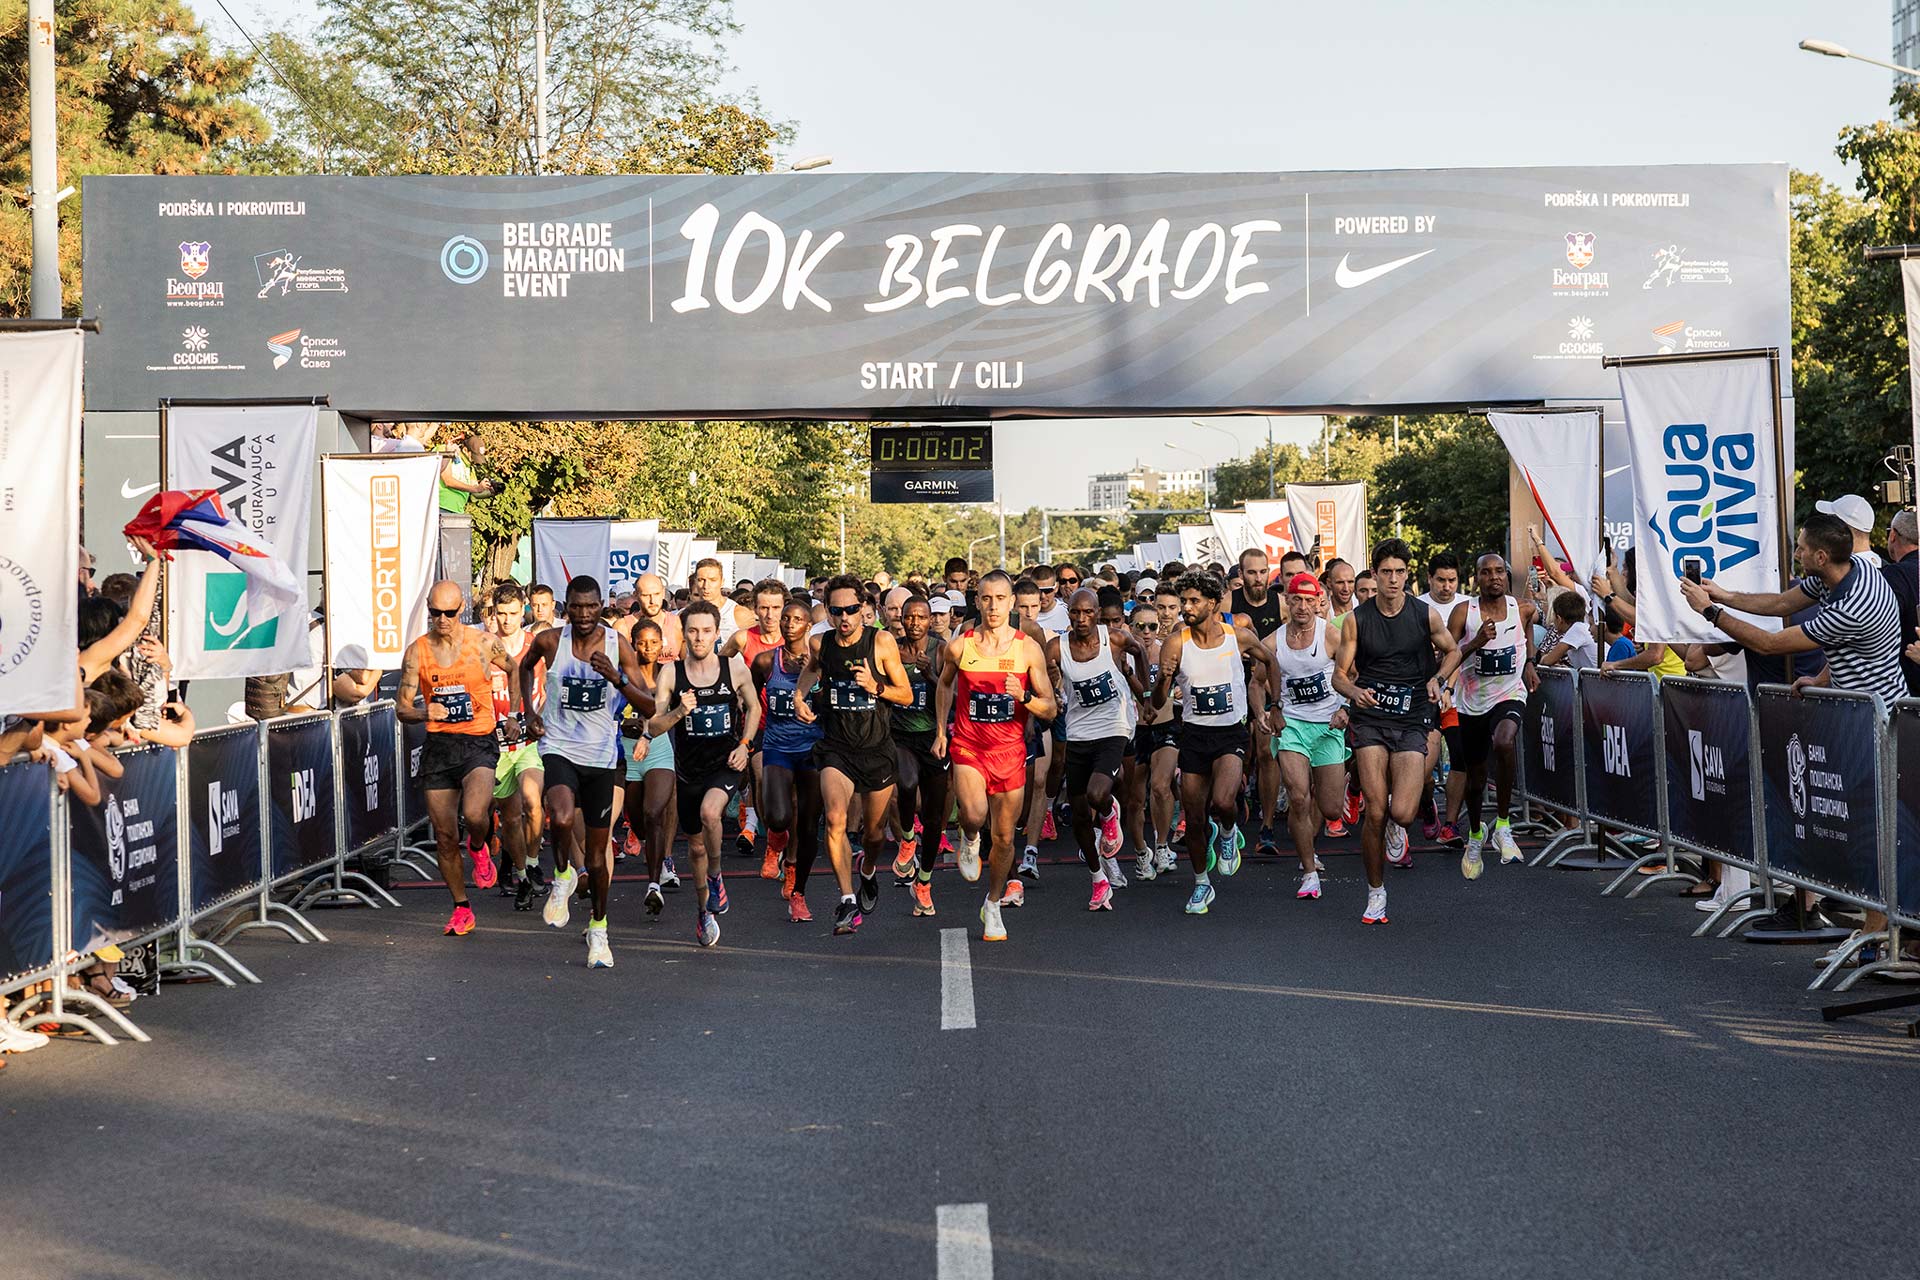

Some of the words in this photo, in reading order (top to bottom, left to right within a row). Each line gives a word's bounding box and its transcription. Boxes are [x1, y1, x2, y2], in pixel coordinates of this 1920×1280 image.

[1544, 190, 1599, 207] PODRŠKA
[1604, 193, 1608, 206] I
[1612, 193, 1690, 207] POKROVITELJI
[158, 200, 214, 216] PODRŠKA
[218, 202, 223, 216] I
[227, 202, 306, 216] POKROVITELJI
[1335, 216, 1408, 235] POWERED
[1415, 216, 1436, 233] BY
[503, 222, 612, 247] BELGRADE
[503, 248, 625, 272] MARATHON
[671, 202, 845, 315] 10K
[863, 217, 1282, 314] BELGRADE
[503, 272, 571, 297] EVENT
[1552, 268, 1608, 290] Београд
[166, 279, 224, 299] Београд
[166, 300, 224, 308] www.beograd.rs
[1684, 327, 1722, 339] Српски
[300, 336, 338, 348] Српски
[1559, 342, 1604, 354] ССОСИБ
[1684, 338, 1730, 348] Атлетски
[173, 353, 218, 364] ССОСИБ
[300, 348, 346, 358] Атлетски
[300, 358, 330, 368] Савез
[860, 362, 938, 390] START
[949, 362, 964, 389] /
[975, 362, 1024, 389] CILJ
[880, 437, 983, 460] 0:00:02
[210, 434, 247, 528] AVA
[248, 434, 264, 539] IGURAVAJUĆA
[265, 434, 277, 544] RUPA
[376, 550, 398, 649] SPORT
[1495, 660, 1498, 668] 1
[582, 692, 589, 702] 2
[848, 694, 856, 702] 5
[1090, 688, 1101, 697] 16
[1298, 685, 1318, 697] 1129
[1208, 698, 1215, 706] 6
[1376, 692, 1400, 706] 1709
[986, 705, 998, 715] 15
[705, 718, 712, 728] 3
[1704, 744, 1726, 780] SAVA
[222, 788, 240, 824] SAVA
